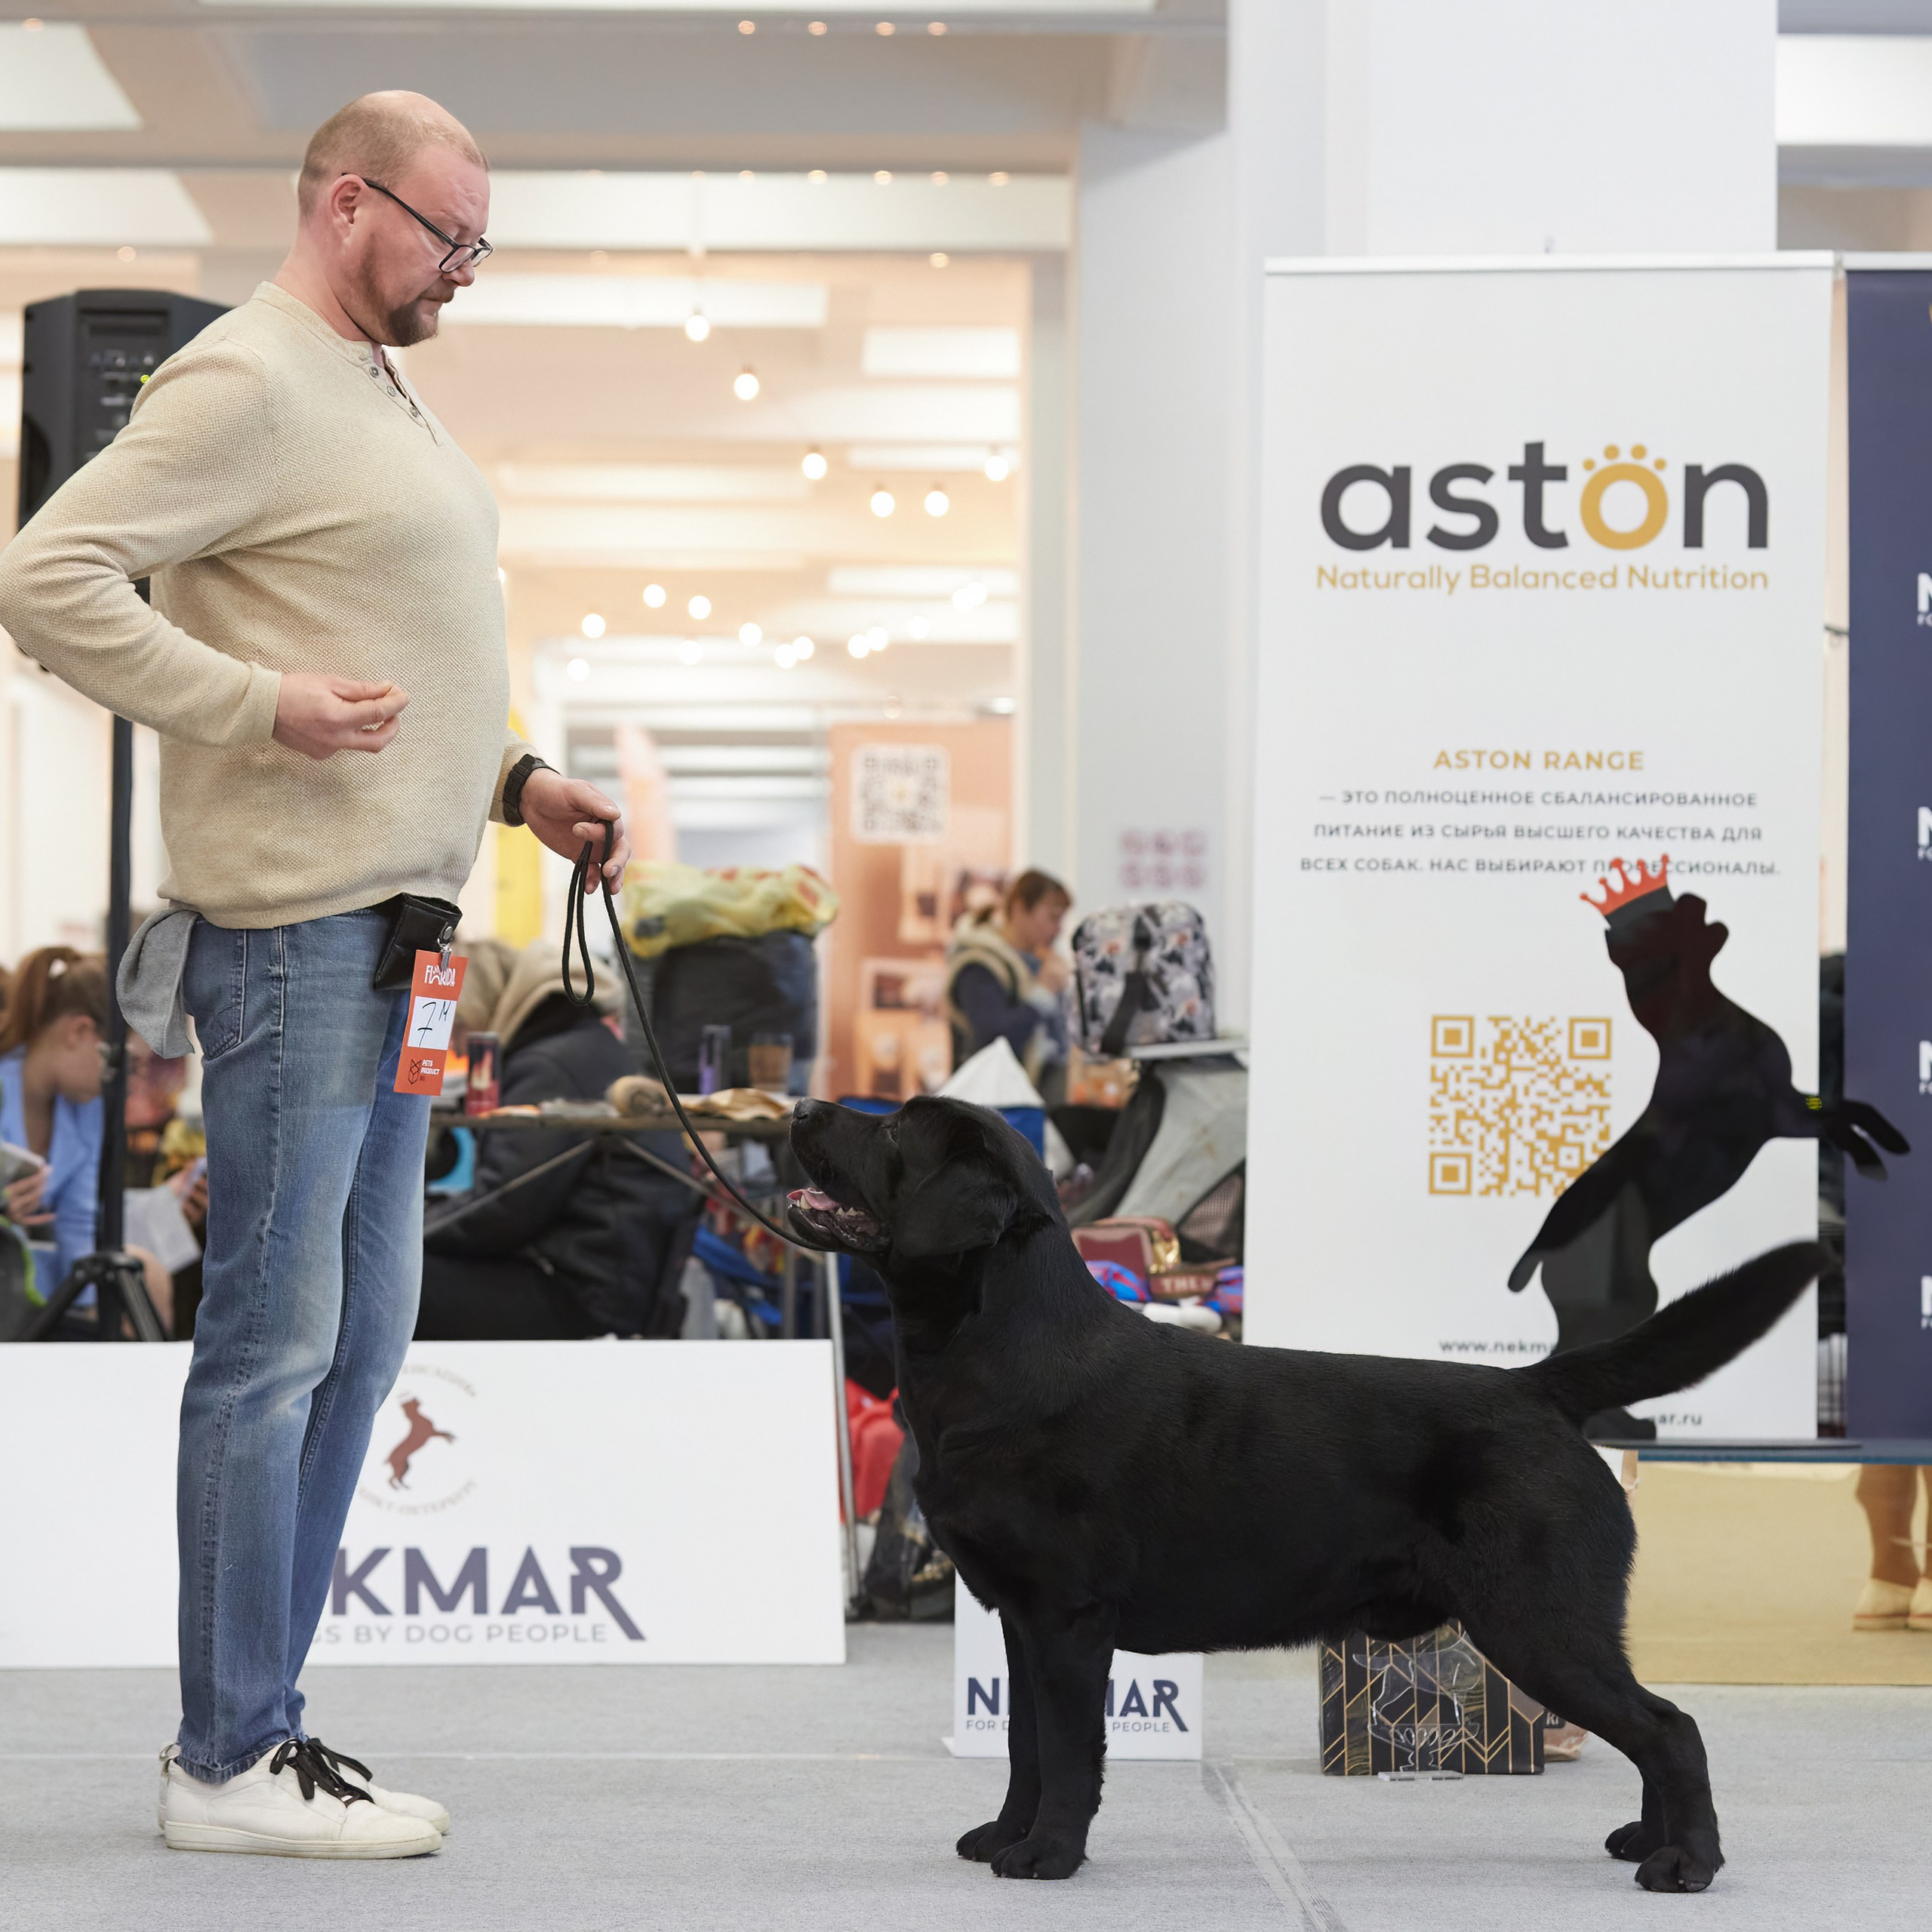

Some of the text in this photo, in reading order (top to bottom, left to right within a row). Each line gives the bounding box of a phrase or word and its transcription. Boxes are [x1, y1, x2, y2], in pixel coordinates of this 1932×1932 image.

[1320, 441, 1769, 552] aston
[1315, 563, 1769, 596] Naturally Balanced Nutrition
[1432, 749, 1644, 772] ASTON RANGE
[1341, 790, 1379, 804] ЭТО
[1384, 790, 1534, 807] ПОЛНОЦЕННОЕ
[1540, 791, 1758, 808] СБАЛАНСИРОВАННОЕ
[1313, 823, 1762, 843] ПИТАНИЕ ИЗ СЫРЬЯ ВЫСШЕГО КАЧЕСТВА ДЛЯ
[1300, 857, 1349, 872] ВСЕХ
[1353, 857, 1425, 873] СОБАК.
[1429, 858, 1469, 872] НАС
[1475, 858, 1586, 874] ВЫБИРАЮТ
[354, 1623, 395, 1644] BY
[405, 1623, 474, 1644] DOG
[485, 1623, 608, 1644] PEOPLE
[965, 1720, 996, 1731] FOR
[1112, 1721, 1171, 1733] PEOPLE
